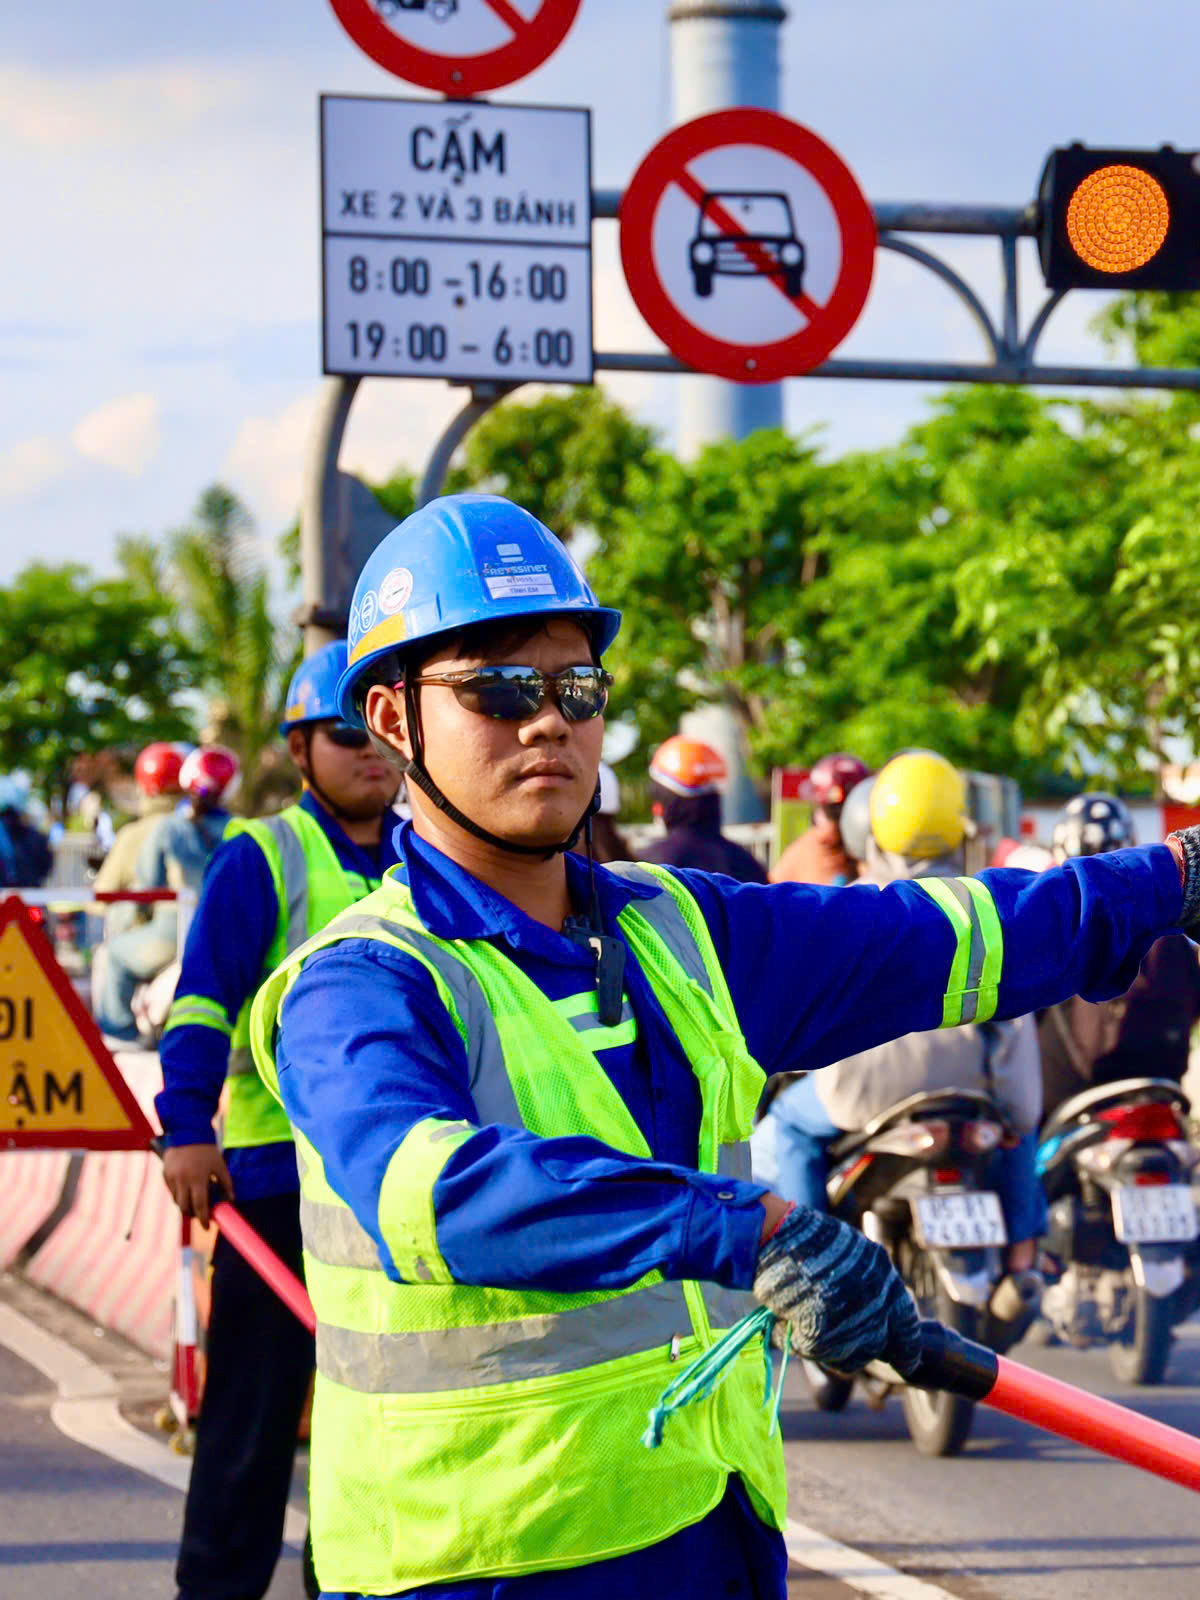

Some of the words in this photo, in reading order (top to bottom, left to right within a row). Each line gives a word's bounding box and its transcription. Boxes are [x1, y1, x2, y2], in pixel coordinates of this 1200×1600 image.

[410, 112, 507, 175] CẤM
[341, 190, 377, 218] XE
[390, 192, 406, 220] 2
[417, 189, 455, 221] VÀ
[466, 196, 483, 224] 3
[494, 191, 577, 226] BÁNH
[348, 256, 431, 296] 8:00
[468, 260, 567, 302] 16:00
[345, 320, 447, 362] 19:00
[493, 326, 574, 367] 6:00
[9, 1061, 84, 1128] ẬM
